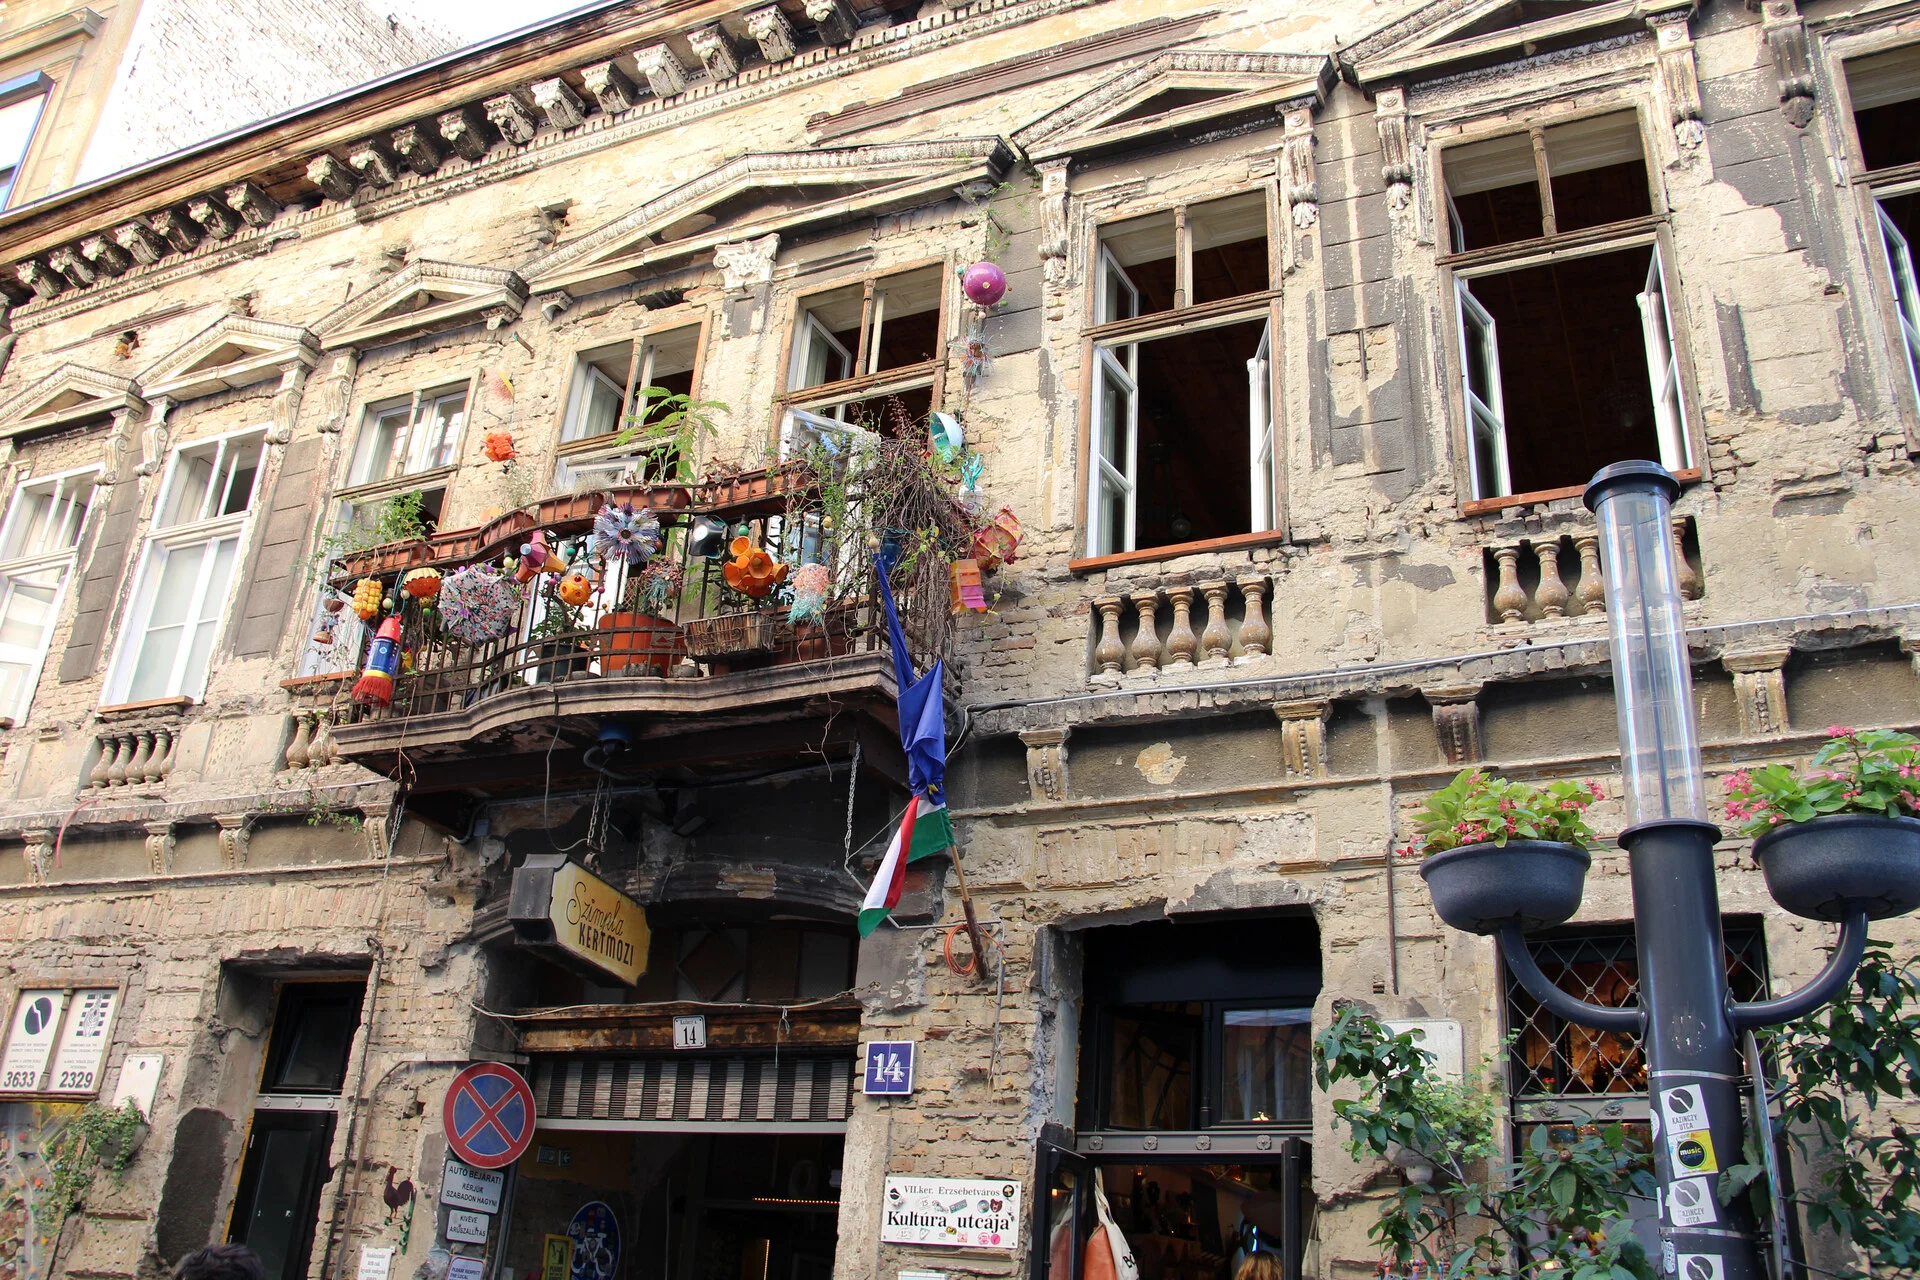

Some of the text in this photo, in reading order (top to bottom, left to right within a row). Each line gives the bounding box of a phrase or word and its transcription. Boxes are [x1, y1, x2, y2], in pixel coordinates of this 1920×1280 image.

[566, 881, 625, 937] Szimpla
[578, 921, 635, 967] KERTMOZI
[683, 1025, 697, 1045] 14
[872, 1052, 906, 1083] 14
[3, 1071, 36, 1088] 3633
[59, 1071, 94, 1089] 2329
[1671, 1113, 1698, 1124] KAZINCZY
[1679, 1122, 1694, 1131] UTCA
[1679, 1146, 1702, 1156] music
[445, 1189, 477, 1203] SZABADON
[938, 1186, 1000, 1196] Erzsébetváros
[887, 1210, 1009, 1234] Kultúra utcája
